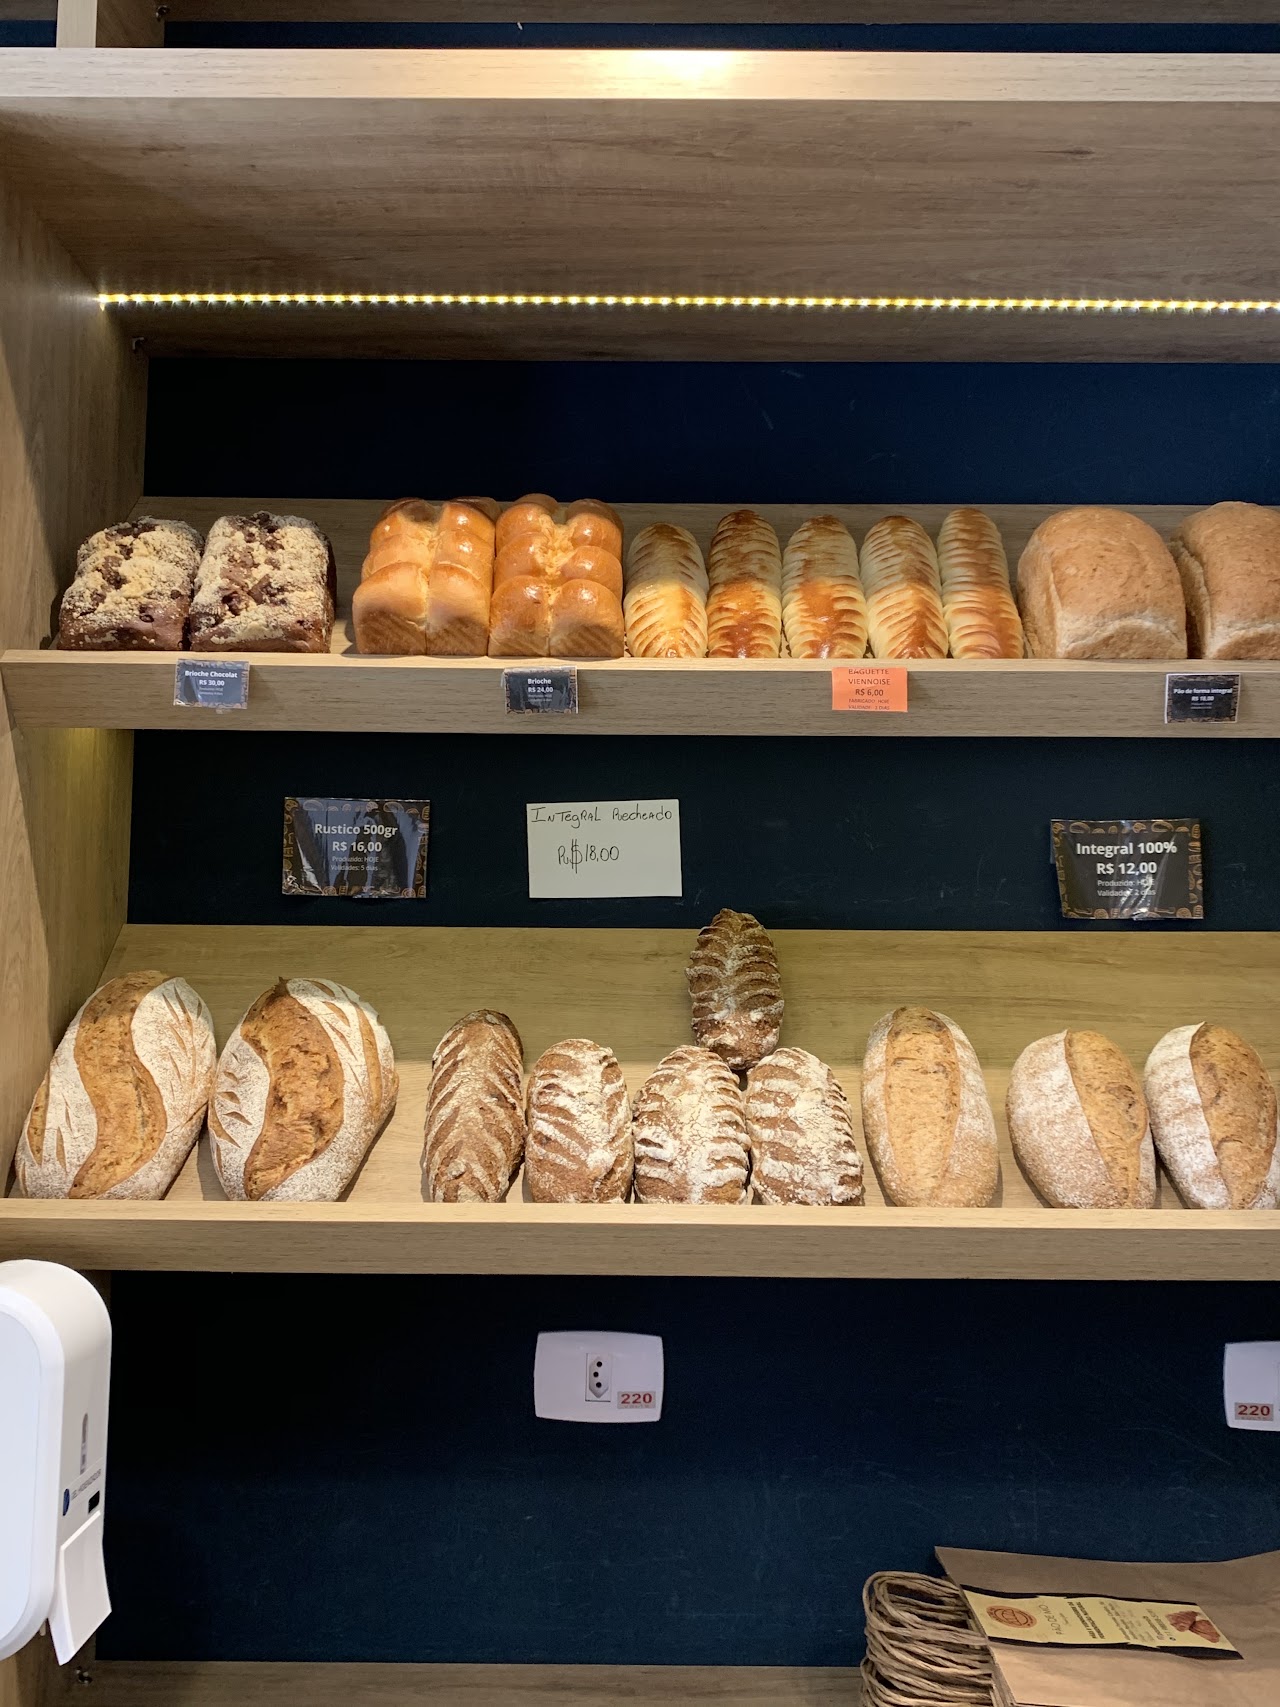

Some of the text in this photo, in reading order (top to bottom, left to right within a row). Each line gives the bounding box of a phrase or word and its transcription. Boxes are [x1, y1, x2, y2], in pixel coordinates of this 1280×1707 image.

[855, 688, 884, 697] R$ 6,00
[314, 823, 398, 838] Rustico 500gr
[332, 841, 382, 853] R$ 16,00
[1076, 841, 1178, 858] Integral 100%
[1096, 862, 1157, 876] R$ 12,00
[621, 1393, 652, 1404] 220
[1237, 1404, 1270, 1416] 220
